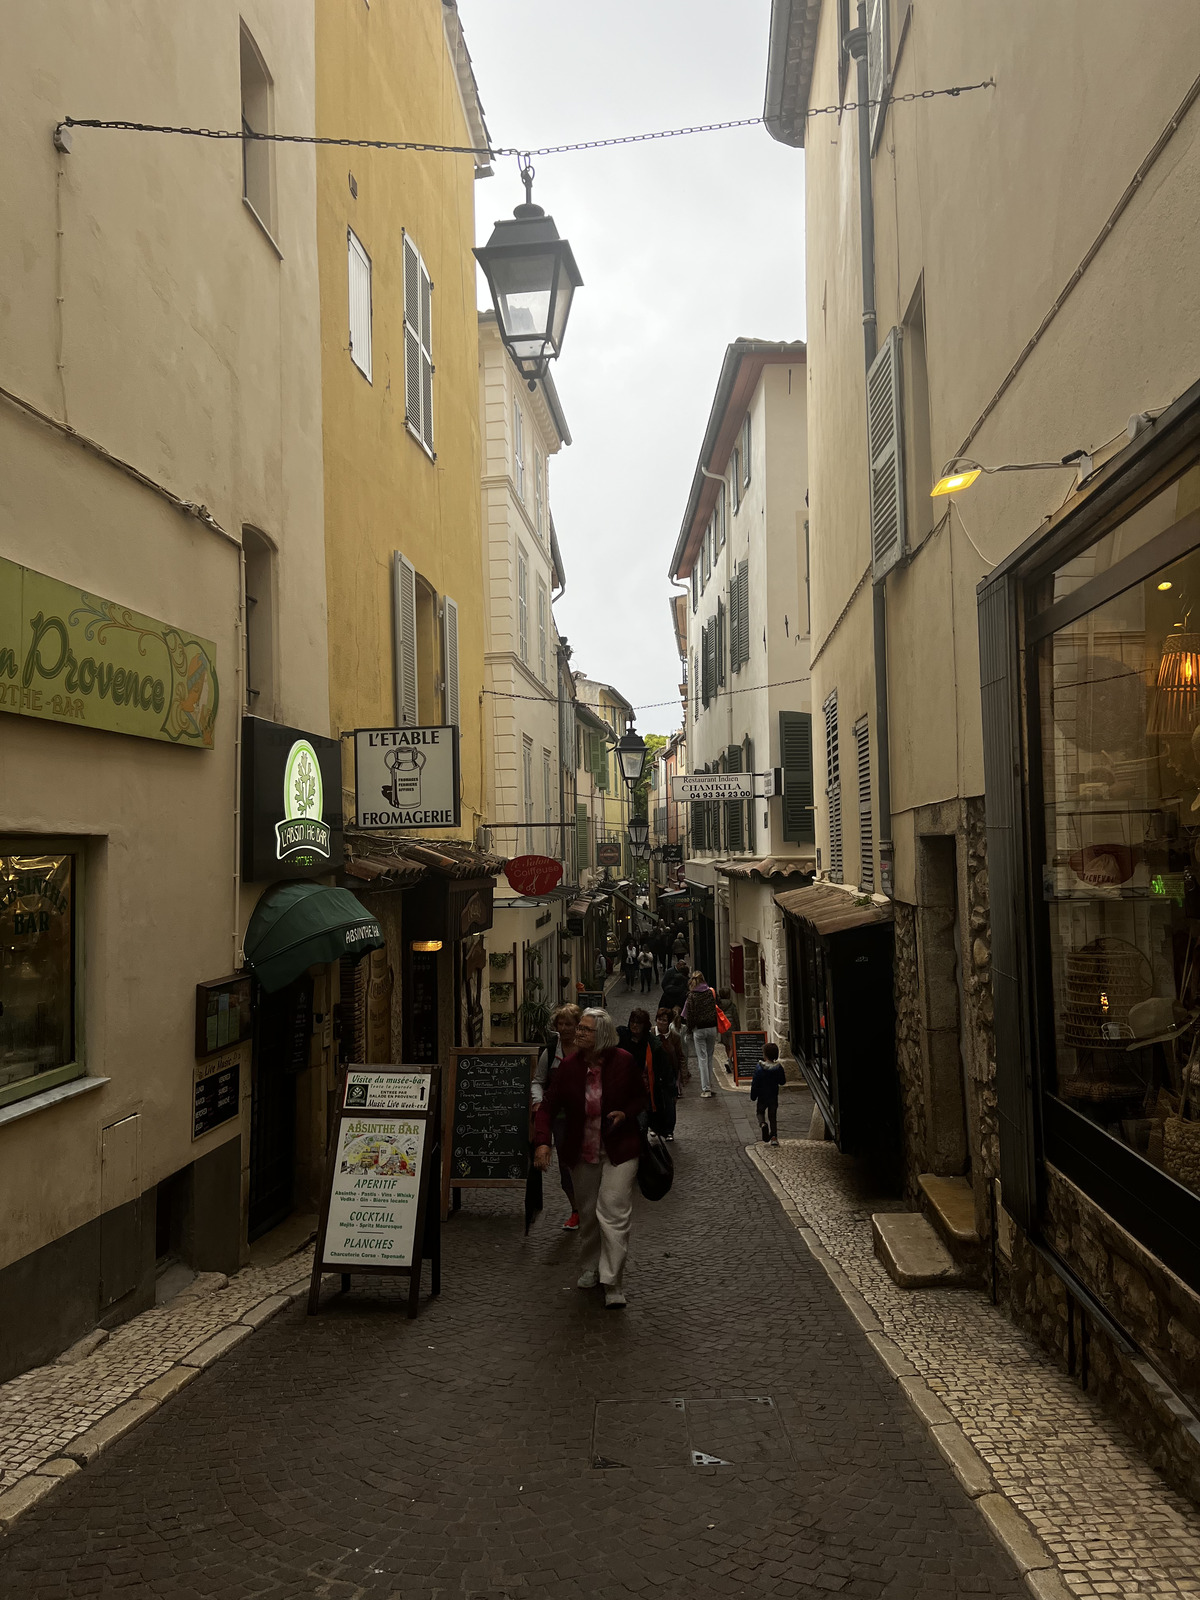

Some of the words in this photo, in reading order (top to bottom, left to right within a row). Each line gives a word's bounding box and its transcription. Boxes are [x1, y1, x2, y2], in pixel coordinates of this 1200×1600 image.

[22, 611, 165, 713] Provence
[368, 730, 440, 747] L'ETABLE
[683, 776, 717, 784] Restaurant
[718, 775, 739, 783] Indien
[681, 783, 742, 792] CHAMKILA
[703, 791, 713, 799] 93
[363, 810, 452, 825] FROMAGERIE
[514, 865, 560, 878] Coiffeuse
[15, 911, 50, 935] BAR
[345, 925, 372, 944] ABSINTHE
[352, 1075, 373, 1083] Visite
[367, 1099, 386, 1108] Music
[387, 1099, 400, 1108] Live
[347, 1123, 396, 1134] ABSINTHE
[398, 1124, 419, 1135] BAR
[354, 1179, 398, 1189] APERITIF
[349, 1211, 395, 1223] COCKTAIL
[344, 1238, 394, 1249] PLANCHES
[381, 1252, 405, 1260] Tapenade
